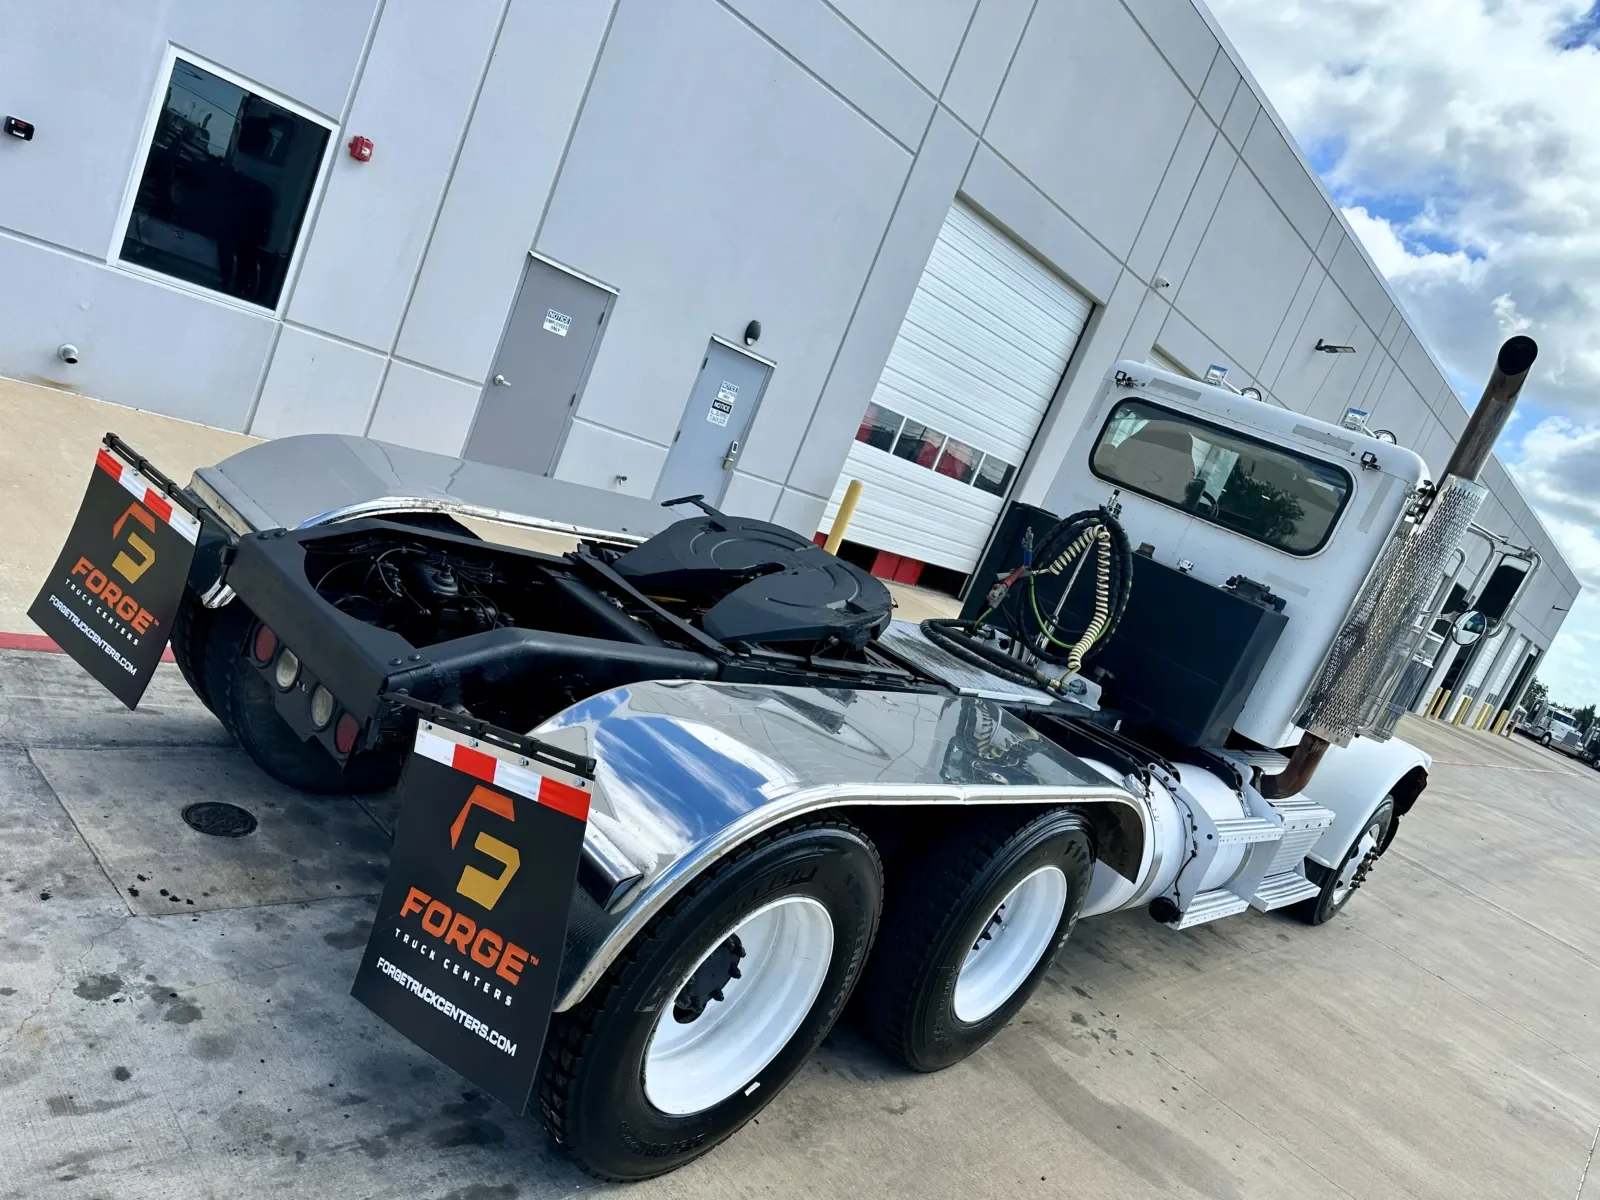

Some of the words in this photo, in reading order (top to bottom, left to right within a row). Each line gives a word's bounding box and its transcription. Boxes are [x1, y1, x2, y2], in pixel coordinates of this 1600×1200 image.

[548, 311, 571, 325] NOTICE
[714, 401, 731, 412] NOTICE
[48, 594, 137, 676] FORGETRUCKCENTERS.COM
[65, 578, 93, 606] TRUCK
[96, 607, 139, 646] CENTERS
[394, 929, 436, 961] TRUCK
[443, 958, 512, 1007] CENTERS
[376, 957, 518, 1056] FORGETRUCKCENTERS.COM
